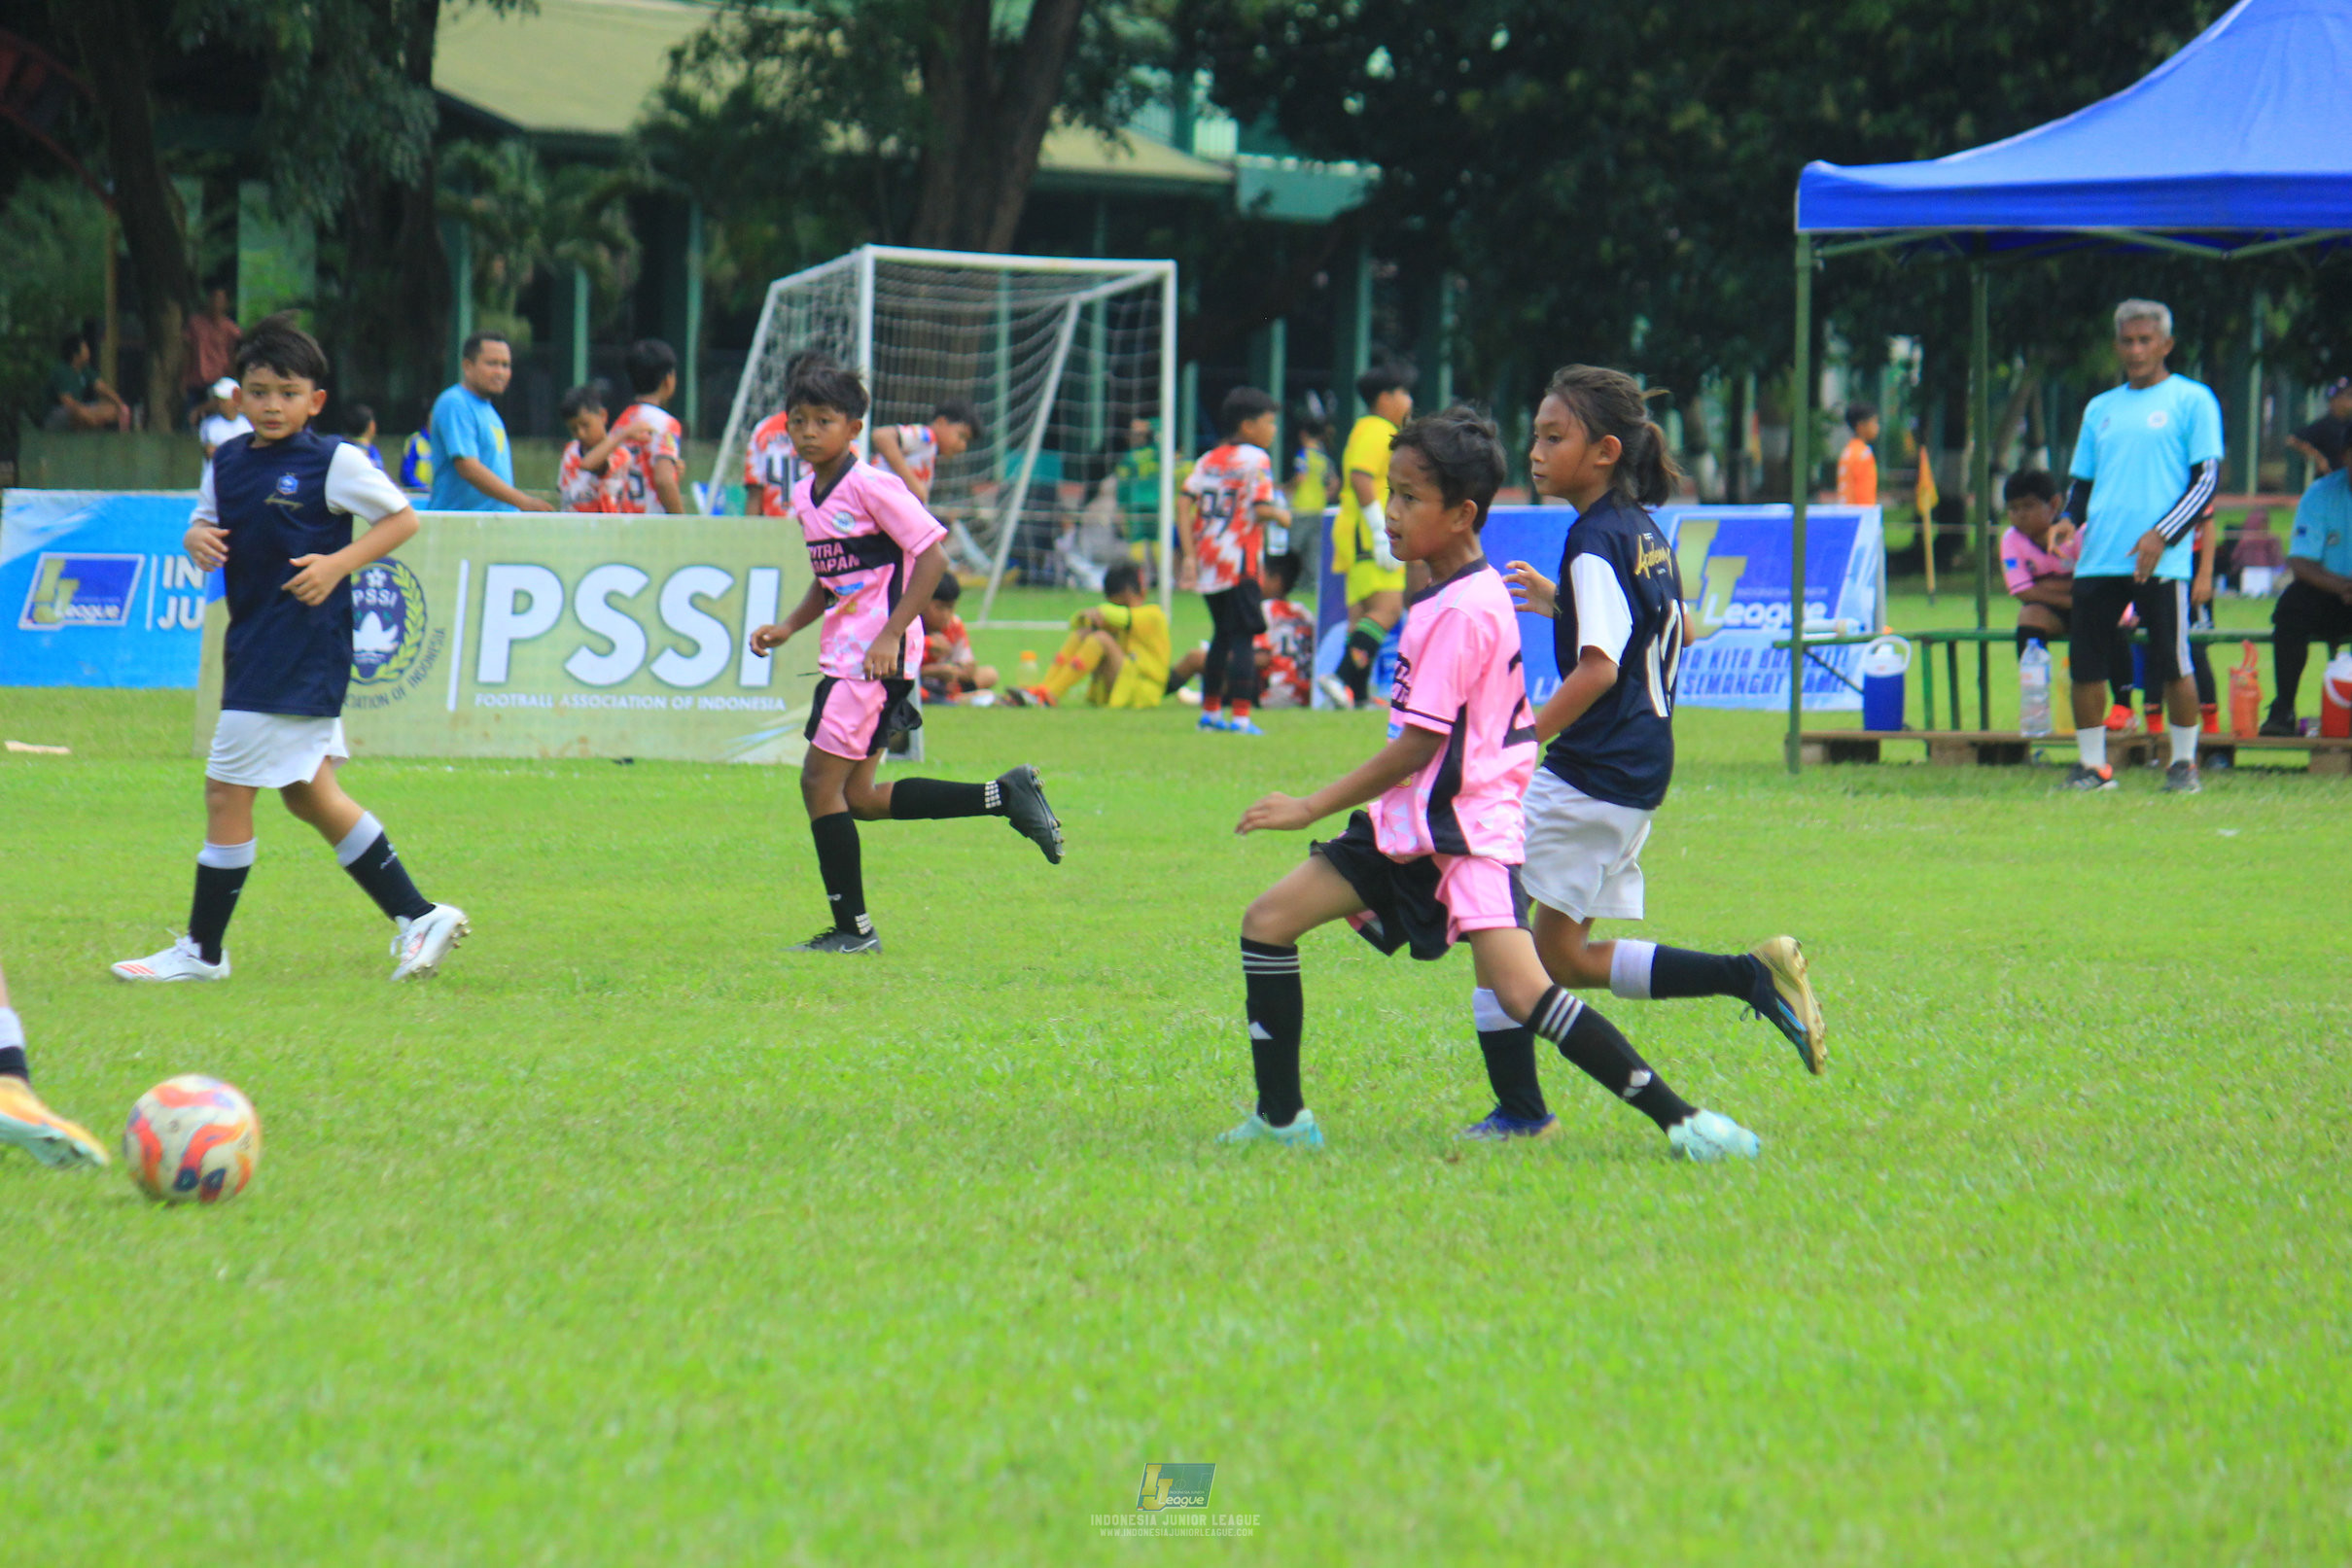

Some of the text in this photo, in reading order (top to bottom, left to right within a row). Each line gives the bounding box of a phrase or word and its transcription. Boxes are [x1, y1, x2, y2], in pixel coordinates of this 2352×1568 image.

[352, 588, 398, 609] PSSI
[476, 563, 780, 687] PSSI
[474, 692, 787, 712] FOOTBALL ASSOCIATION OF INDONESIA
